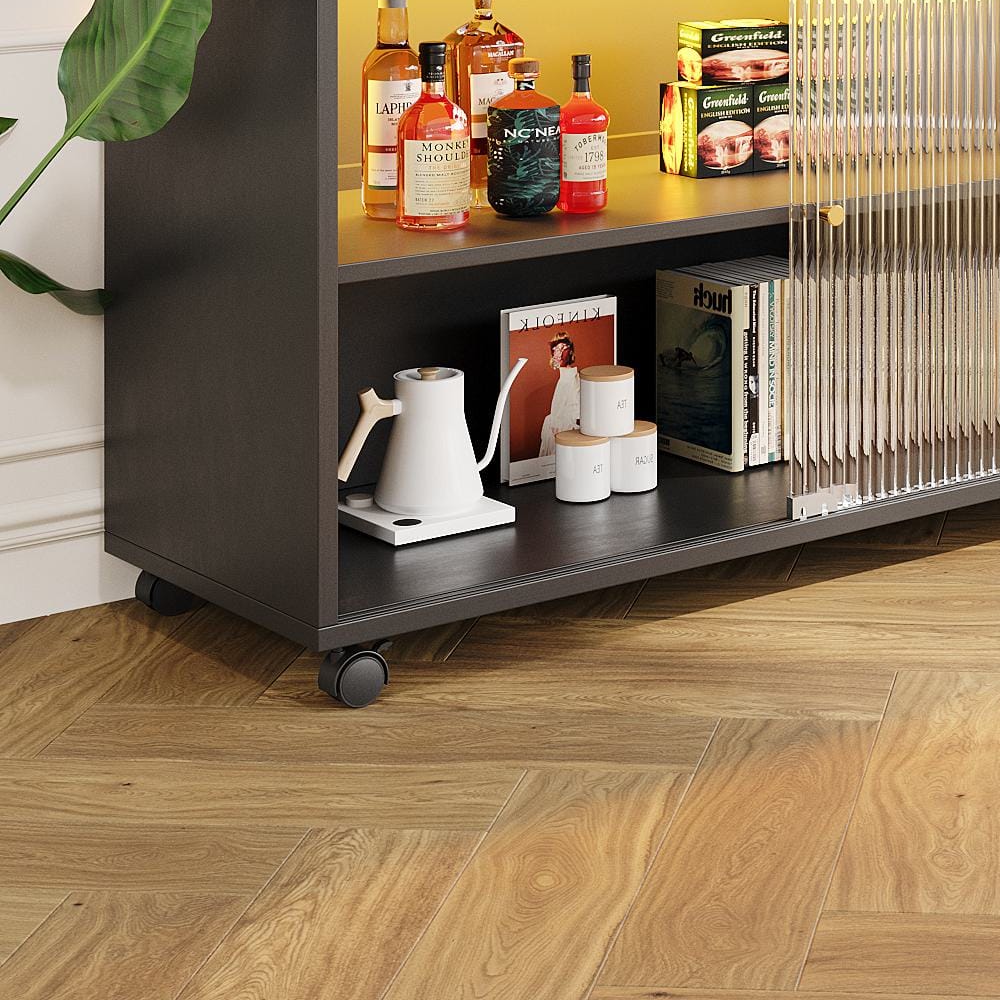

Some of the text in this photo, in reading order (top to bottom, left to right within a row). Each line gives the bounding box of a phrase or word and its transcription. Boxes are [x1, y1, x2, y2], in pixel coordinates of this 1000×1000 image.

[711, 31, 782, 43] Greenfield
[703, 94, 747, 109] Greenfield
[700, 111, 725, 119] ENGLISH
[725, 108, 750, 116] EDITION
[757, 105, 780, 113] ENGLISH
[585, 151, 604, 163] 1798
[769, 368, 775, 379] IN
